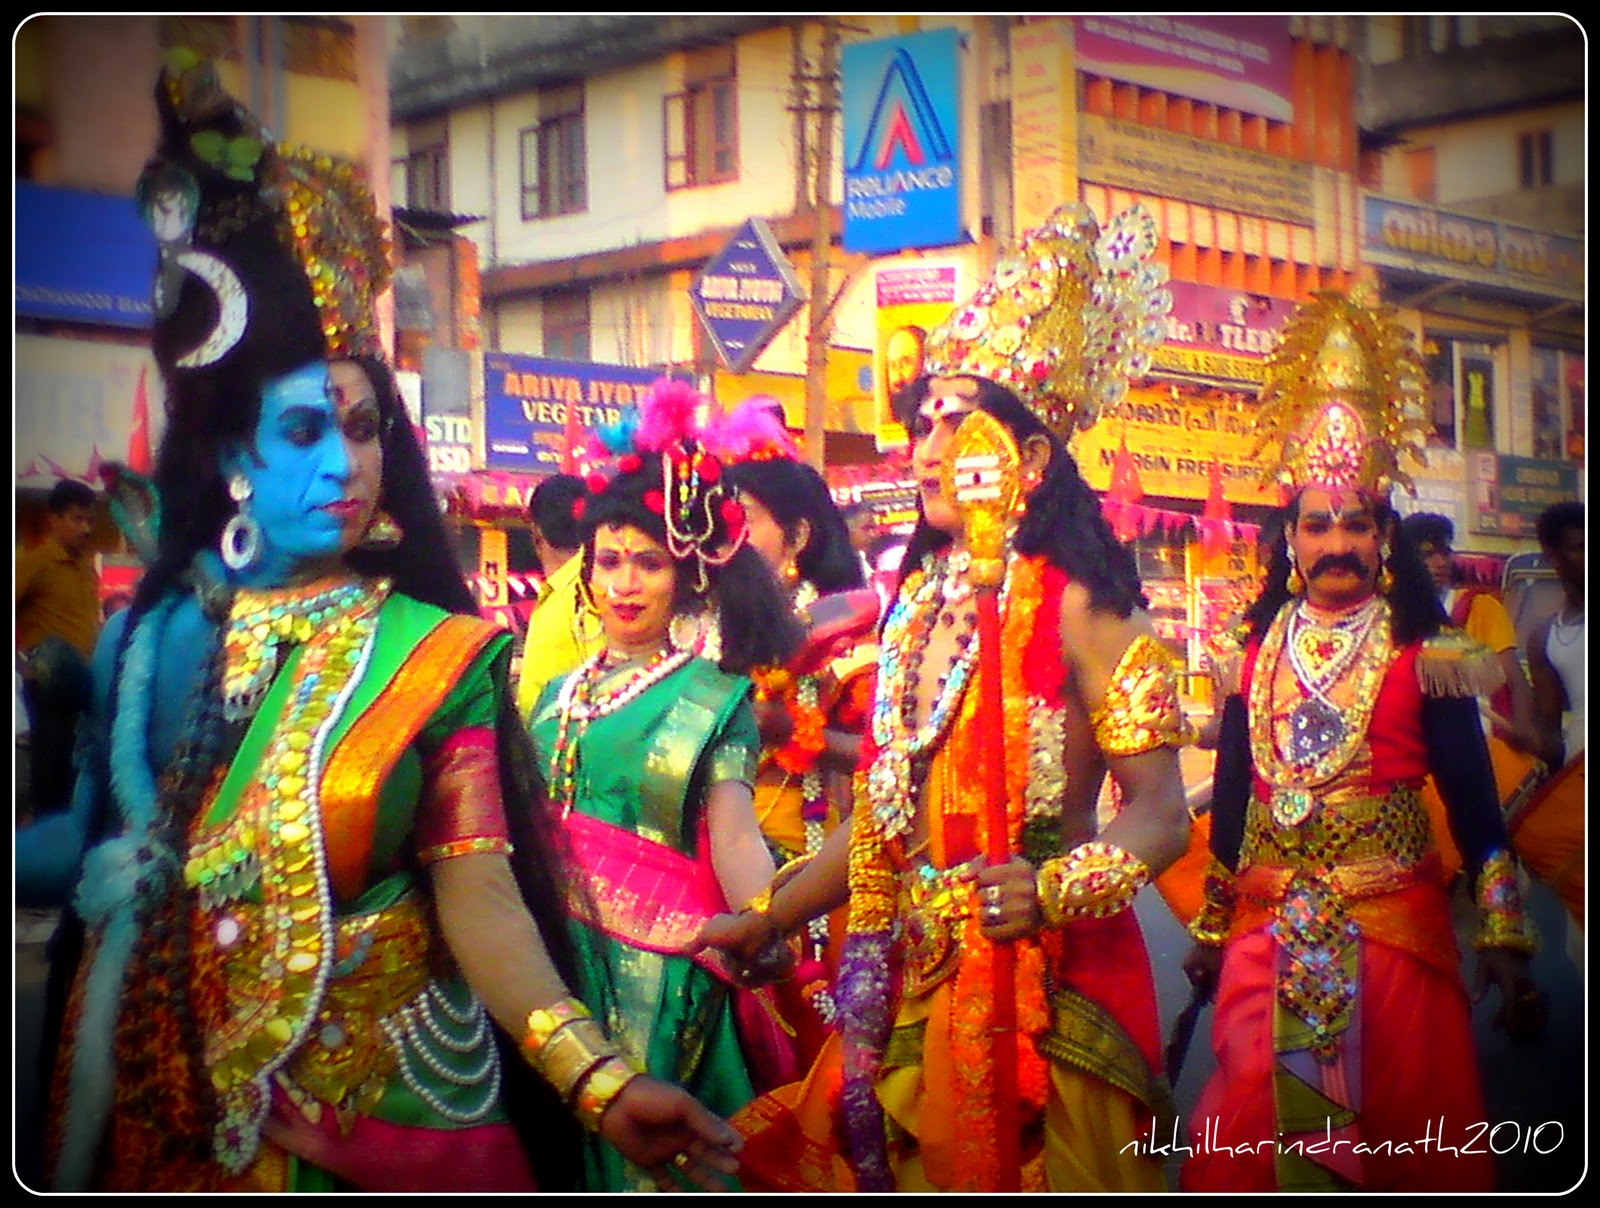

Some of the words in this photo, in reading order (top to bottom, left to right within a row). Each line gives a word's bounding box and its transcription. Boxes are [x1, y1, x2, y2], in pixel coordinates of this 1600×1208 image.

[588, 379, 652, 406] JYOT
[427, 415, 472, 443] STD
[1099, 449, 1171, 471] MRGIN
[1176, 458, 1212, 476] FRE
